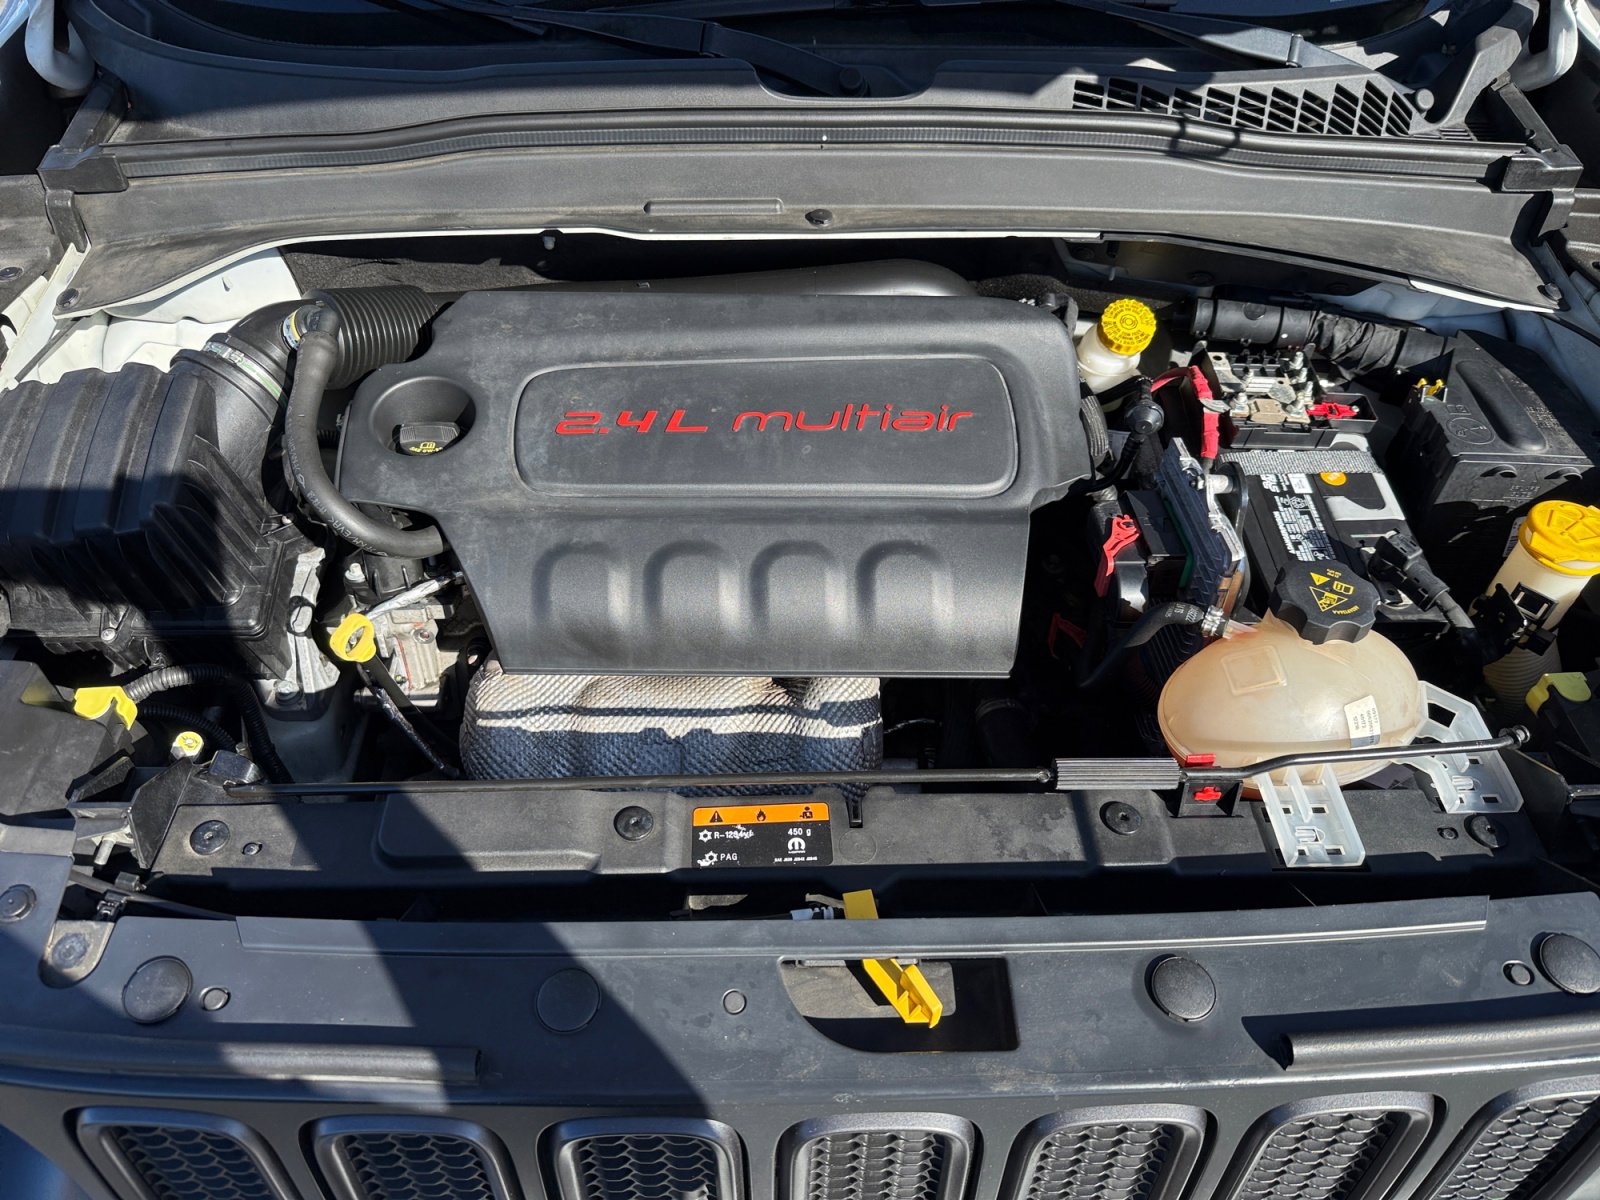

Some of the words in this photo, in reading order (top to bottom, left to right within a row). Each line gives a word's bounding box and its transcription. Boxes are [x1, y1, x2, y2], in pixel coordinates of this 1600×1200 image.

[554, 410, 709, 434] 2.4L
[732, 403, 975, 432] multiair
[788, 827, 803, 836] 450
[805, 828, 812, 837] g
[720, 853, 737, 861] PAG
